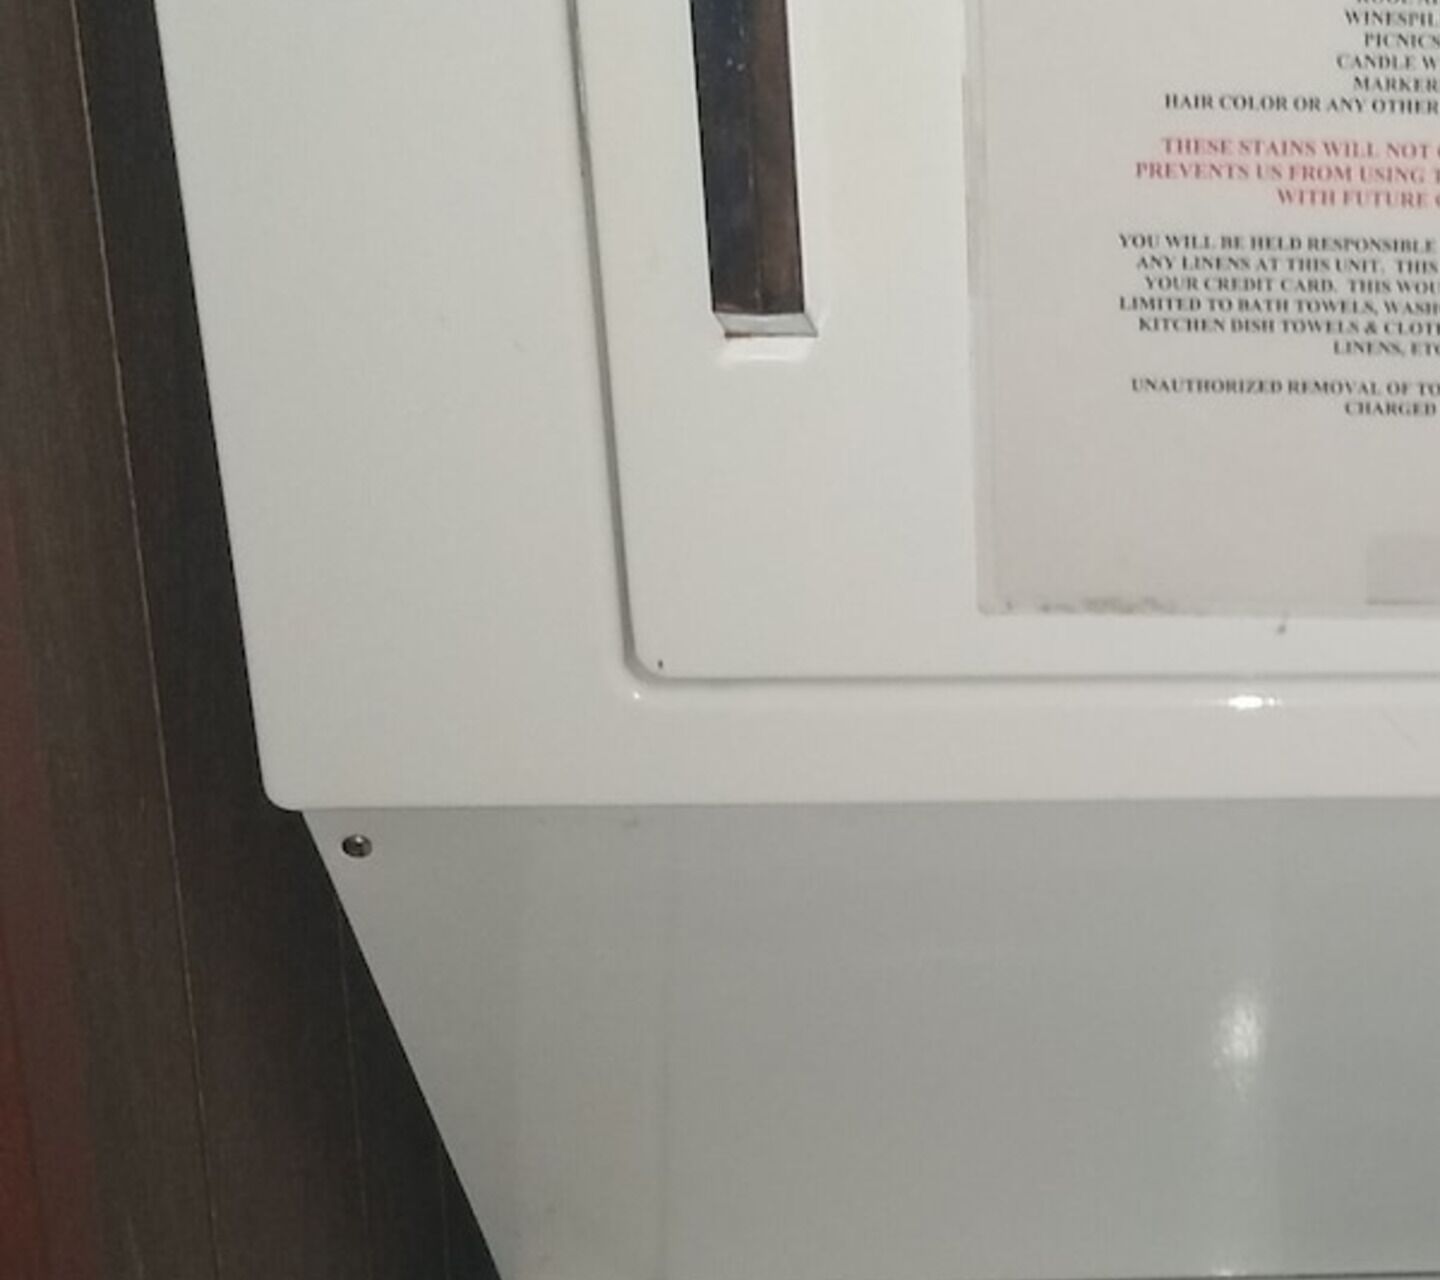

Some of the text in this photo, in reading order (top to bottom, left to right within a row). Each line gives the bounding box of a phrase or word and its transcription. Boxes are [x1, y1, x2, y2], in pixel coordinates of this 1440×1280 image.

[1364, 32, 1440, 51] PICNICS
[1336, 53, 1416, 71] CANDLE
[1165, 93, 1213, 110] HAIR
[1219, 94, 1288, 111] COLOR
[1293, 96, 1320, 112] OR
[1326, 97, 1366, 113] ANY
[1372, 98, 1438, 114] OTHER
[1162, 137, 1232, 155] THESE
[1238, 138, 1316, 157] STAINS
[1322, 140, 1379, 158] WILL
[1386, 142, 1431, 160] NOT
[1136, 161, 1249, 180] PREVENTS
[1256, 163, 1283, 180] US
[1288, 163, 1352, 183] FROM
[1360, 165, 1425, 184] USING
[1277, 188, 1335, 206] WITH
[1343, 189, 1428, 209] FUTURE
[1119, 233, 1159, 249] YOU
[1165, 234, 1215, 250] WILL
[1221, 235, 1244, 250] BE
[1250, 236, 1302, 251] HELD
[1307, 236, 1436, 256] RESPONSIBLE
[1136, 255, 1176, 270] ANY
[1182, 255, 1250, 271] LINENS
[1255, 256, 1281, 272] AT
[1286, 257, 1330, 273] THIS
[1396, 259, 1438, 275] THIS
[1145, 275, 1199, 291] YOUR
[1203, 276, 1274, 292] CREDIT
[1347, 278, 1392, 295] THIS
[1120, 296, 1201, 312] LIMITED
[1206, 297, 1233, 312] TO
[1237, 297, 1289, 314] BATH
[1294, 299, 1378, 318] TOWELS,
[1139, 316, 1225, 332] KITCHEN
[1230, 318, 1275, 333] DISH
[1280, 319, 1359, 334] TOWELS
[1364, 320, 1378, 336] &
[1132, 378, 1283, 394] UNAUTHORIZED
[1288, 379, 1381, 396] REMOVAL
[1386, 381, 1411, 396] OF
[1344, 400, 1437, 416] CHARGED
